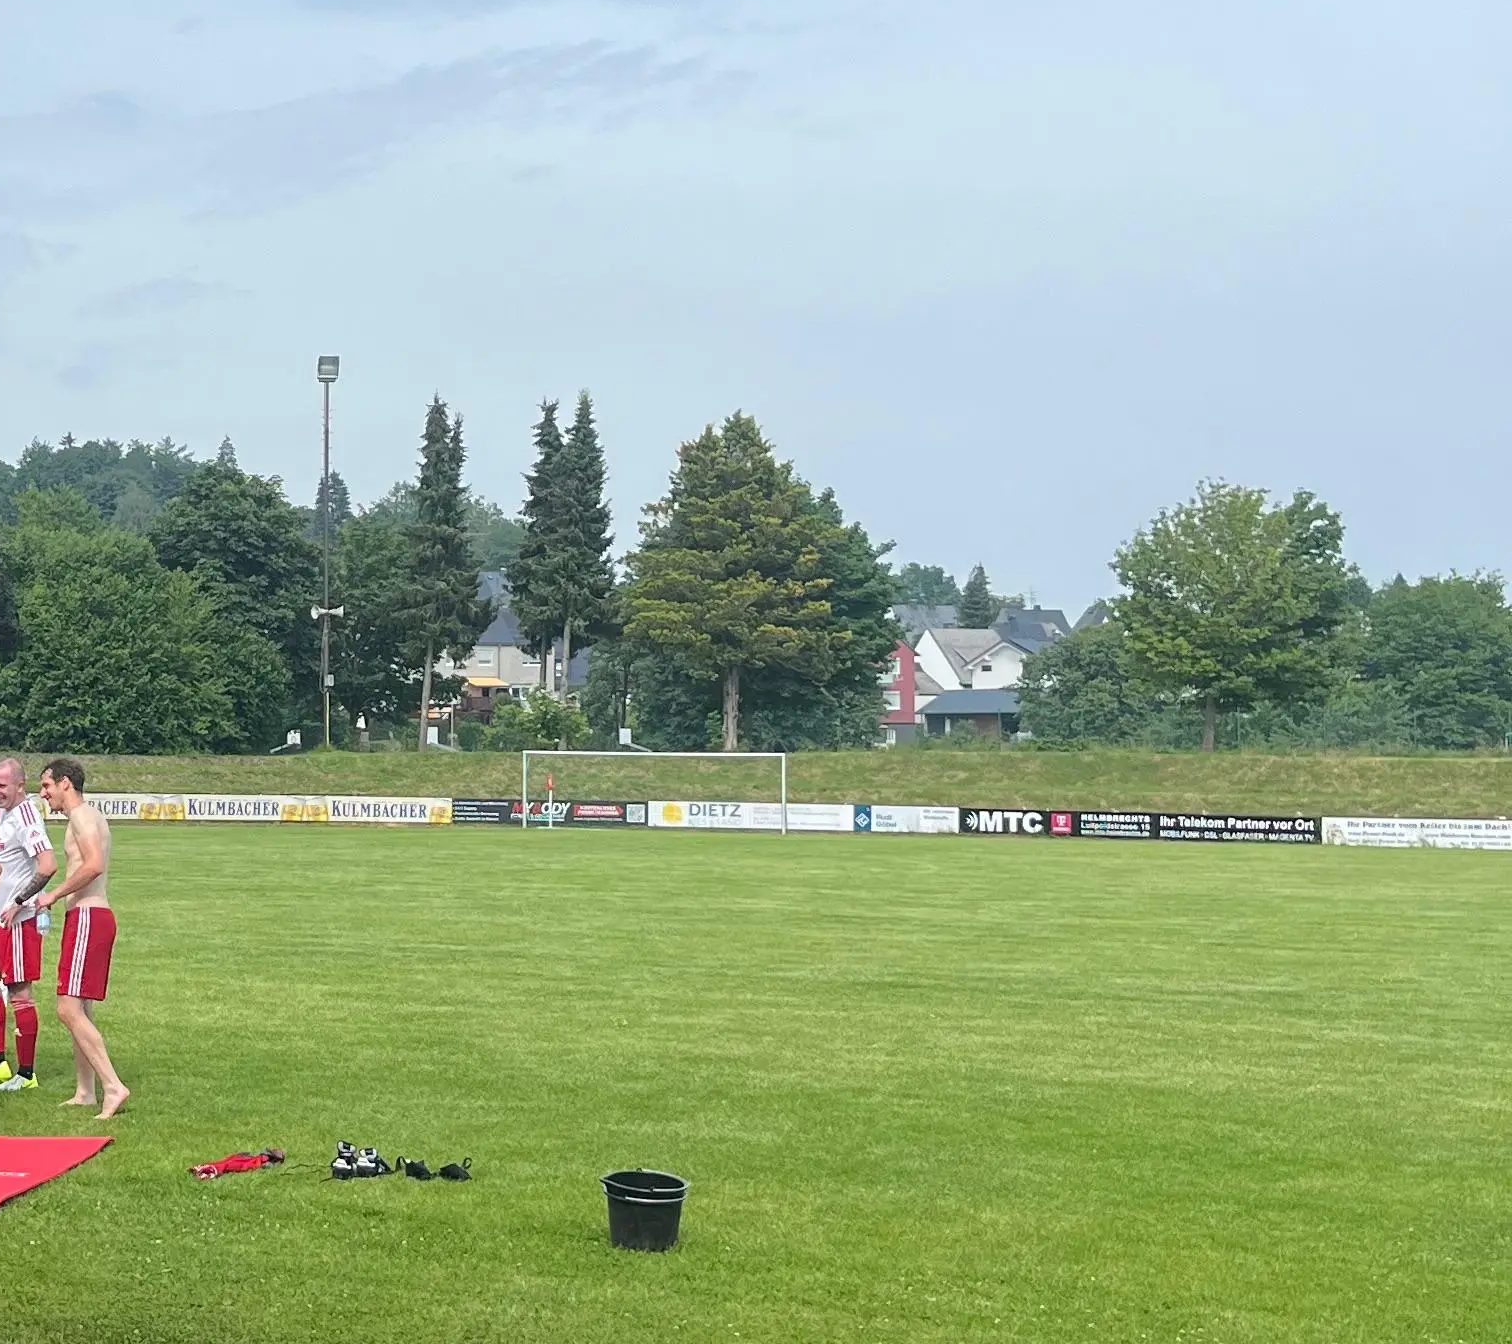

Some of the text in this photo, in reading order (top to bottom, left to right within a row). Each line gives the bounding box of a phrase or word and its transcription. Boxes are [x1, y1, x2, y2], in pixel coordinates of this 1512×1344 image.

[188, 798, 279, 816] KULMBACHER
[331, 800, 427, 819] KULMBACHER
[689, 804, 741, 817] DIETZ
[979, 811, 1043, 833] MTC
[1080, 814, 1151, 823] HELMBRECHTS
[1159, 815, 1315, 831] Ihr Telekom Partner vor Ort
